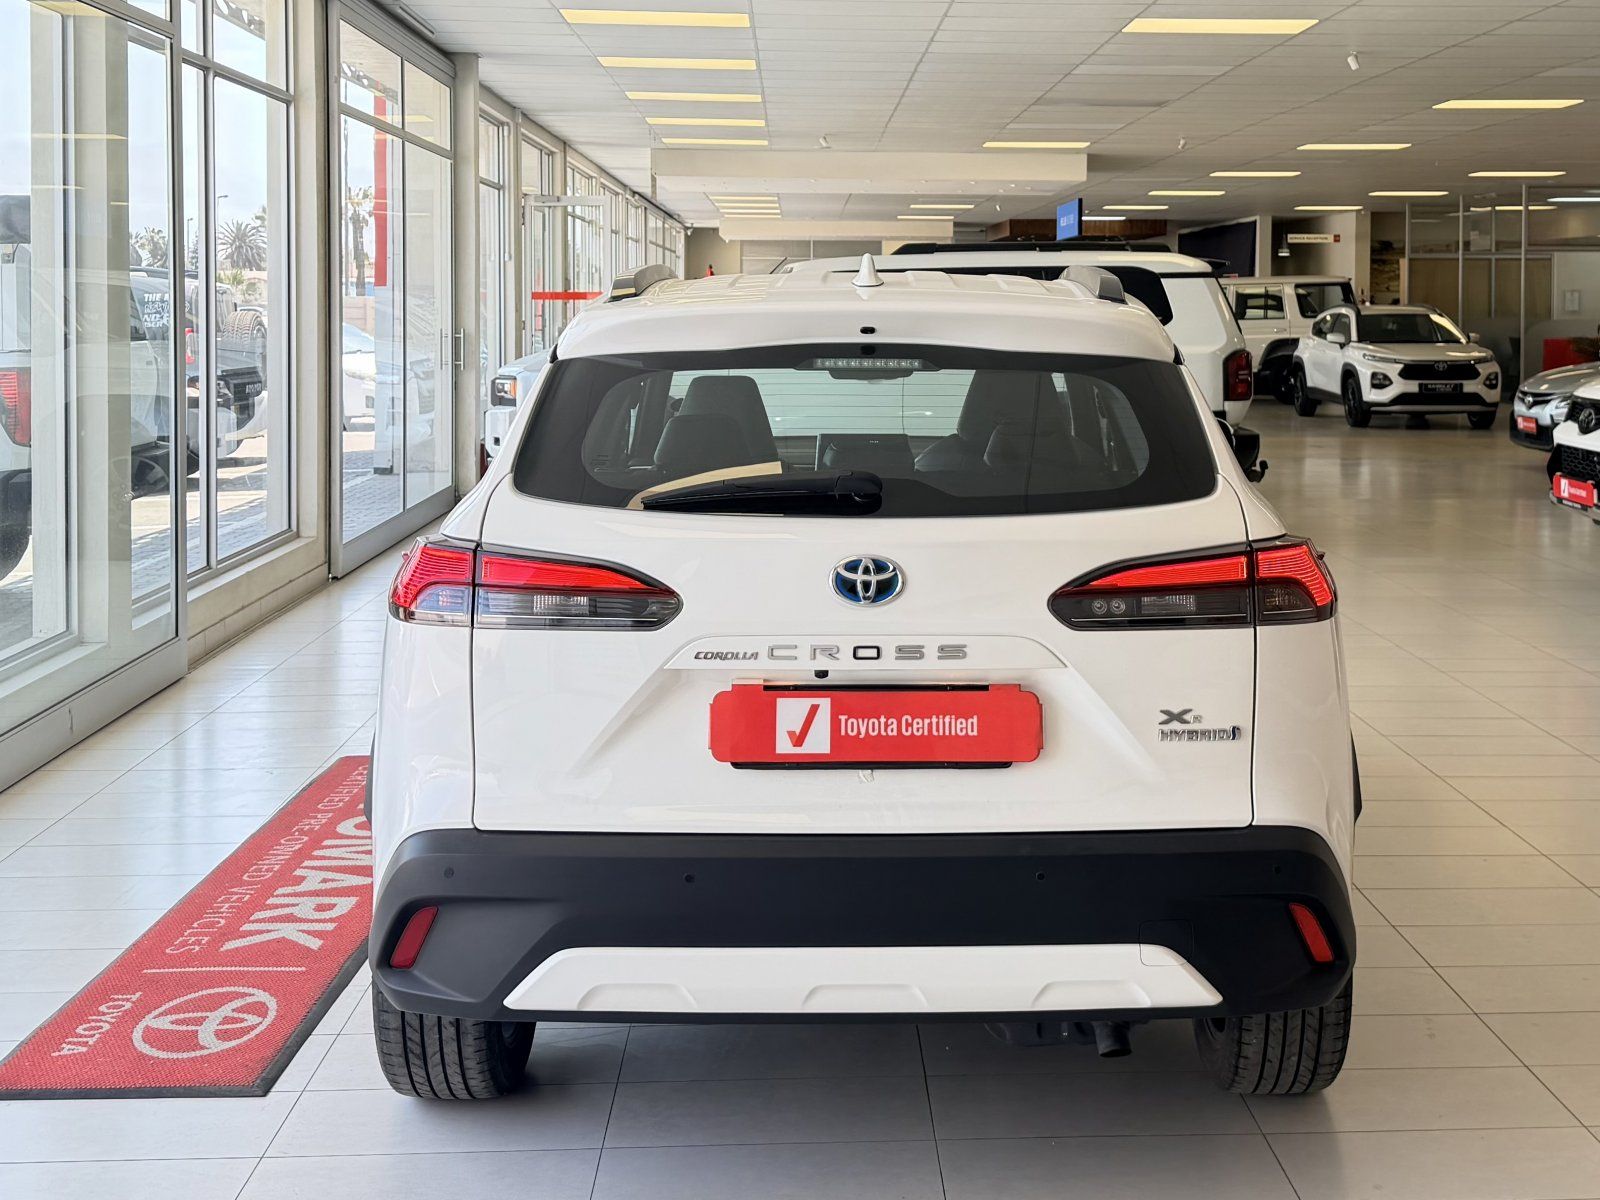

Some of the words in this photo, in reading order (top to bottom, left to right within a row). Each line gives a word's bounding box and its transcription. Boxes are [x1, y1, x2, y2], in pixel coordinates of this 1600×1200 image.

[694, 651, 759, 661] COROLLA
[767, 644, 968, 661] CROSS
[838, 714, 898, 738] Toyota
[901, 714, 978, 736] Certified
[1158, 728, 1229, 741] HYBRID
[242, 812, 334, 881] PRE-OWNED
[165, 884, 261, 954] VEHICLES
[50, 991, 143, 1057] TOYOTA
